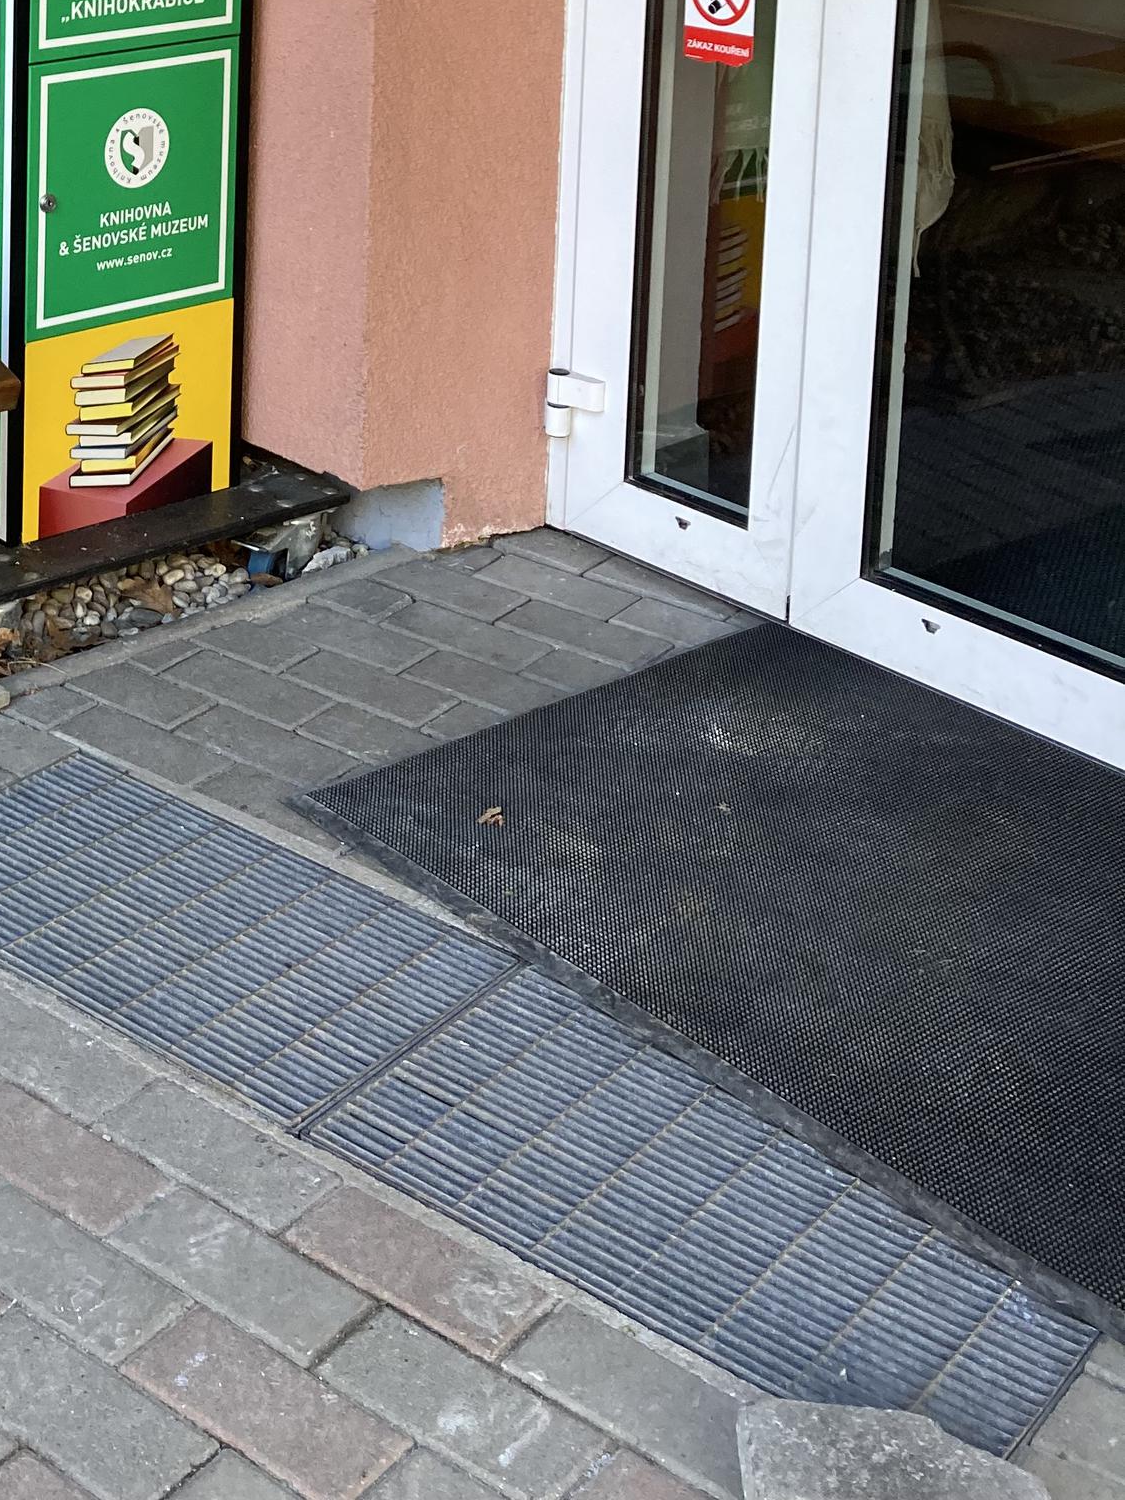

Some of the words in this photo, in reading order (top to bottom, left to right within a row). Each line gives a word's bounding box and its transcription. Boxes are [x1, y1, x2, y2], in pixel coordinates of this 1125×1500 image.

[686, 38, 714, 51] ZÁKAZ
[714, 43, 751, 58] KOUŘENÍ
[100, 201, 172, 228] KNIHOVNA
[58, 241, 70, 256] &
[73, 223, 148, 254] ŠENOVSKÉ
[151, 214, 209, 239] MUZEUM
[96, 247, 173, 271] www.senov.cz
